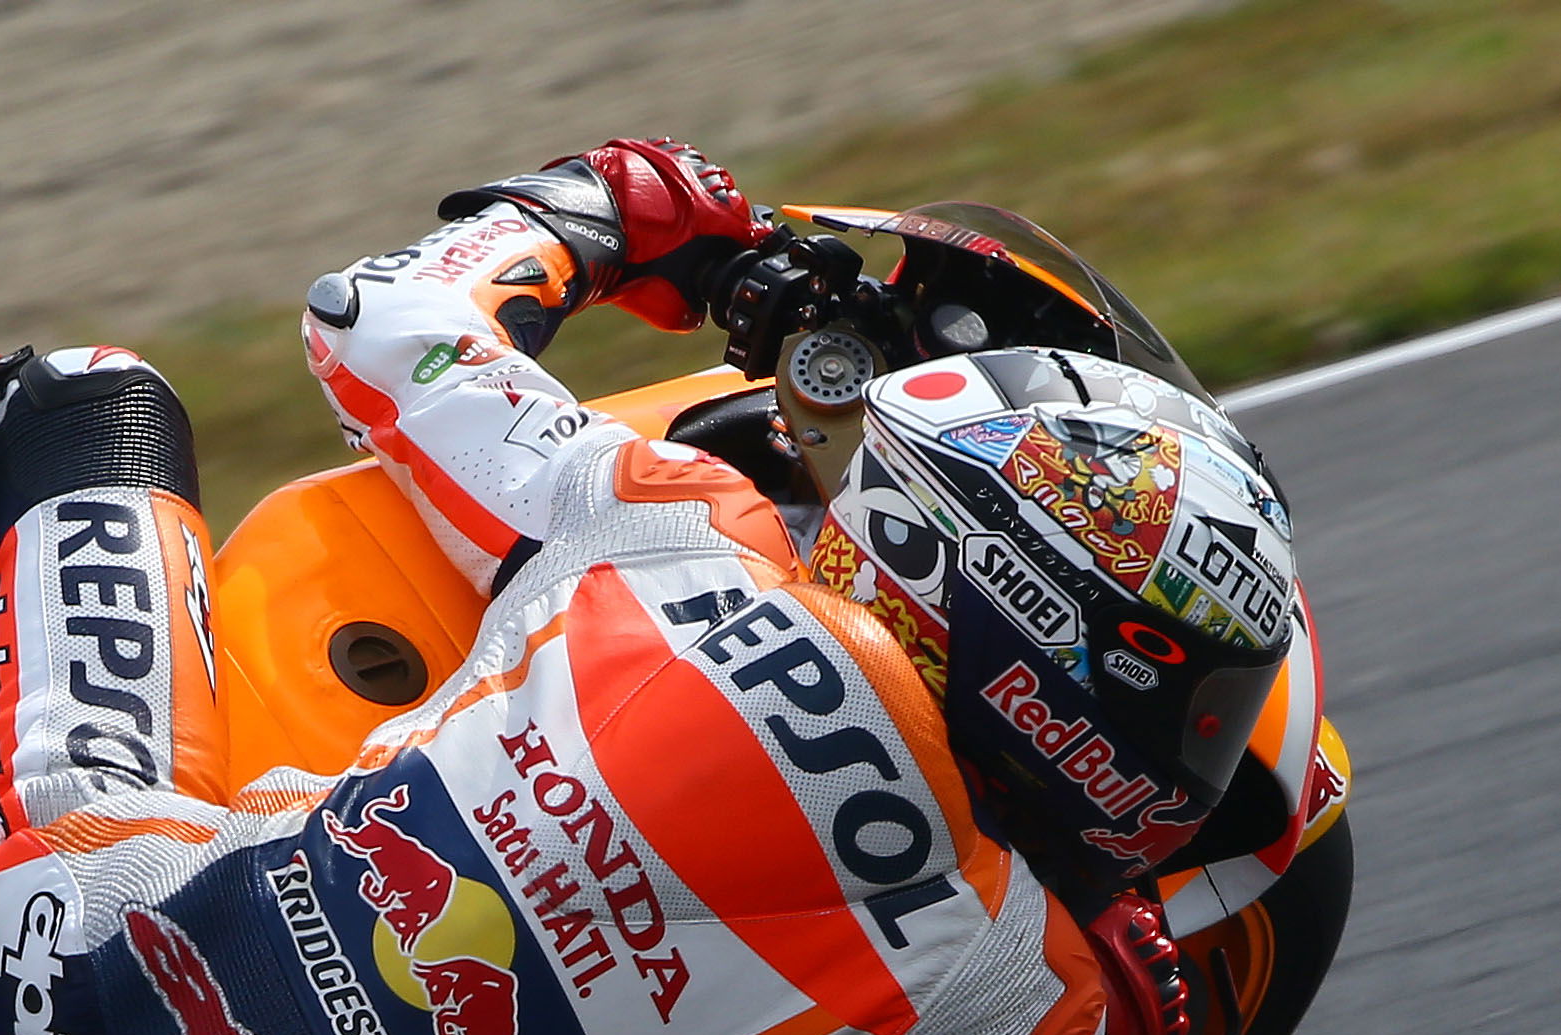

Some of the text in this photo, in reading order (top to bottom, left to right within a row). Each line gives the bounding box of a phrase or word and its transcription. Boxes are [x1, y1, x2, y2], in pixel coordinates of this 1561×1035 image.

[970, 543, 1072, 640] SHOEI
[1176, 522, 1282, 637] LOTUS
[56, 500, 159, 793] REPSO
[1112, 653, 1155, 689] SHOEI
[979, 660, 1092, 760] Red
[1056, 734, 1159, 821] Bull
[473, 790, 540, 877] Satu
[497, 717, 690, 1025] HONDA
